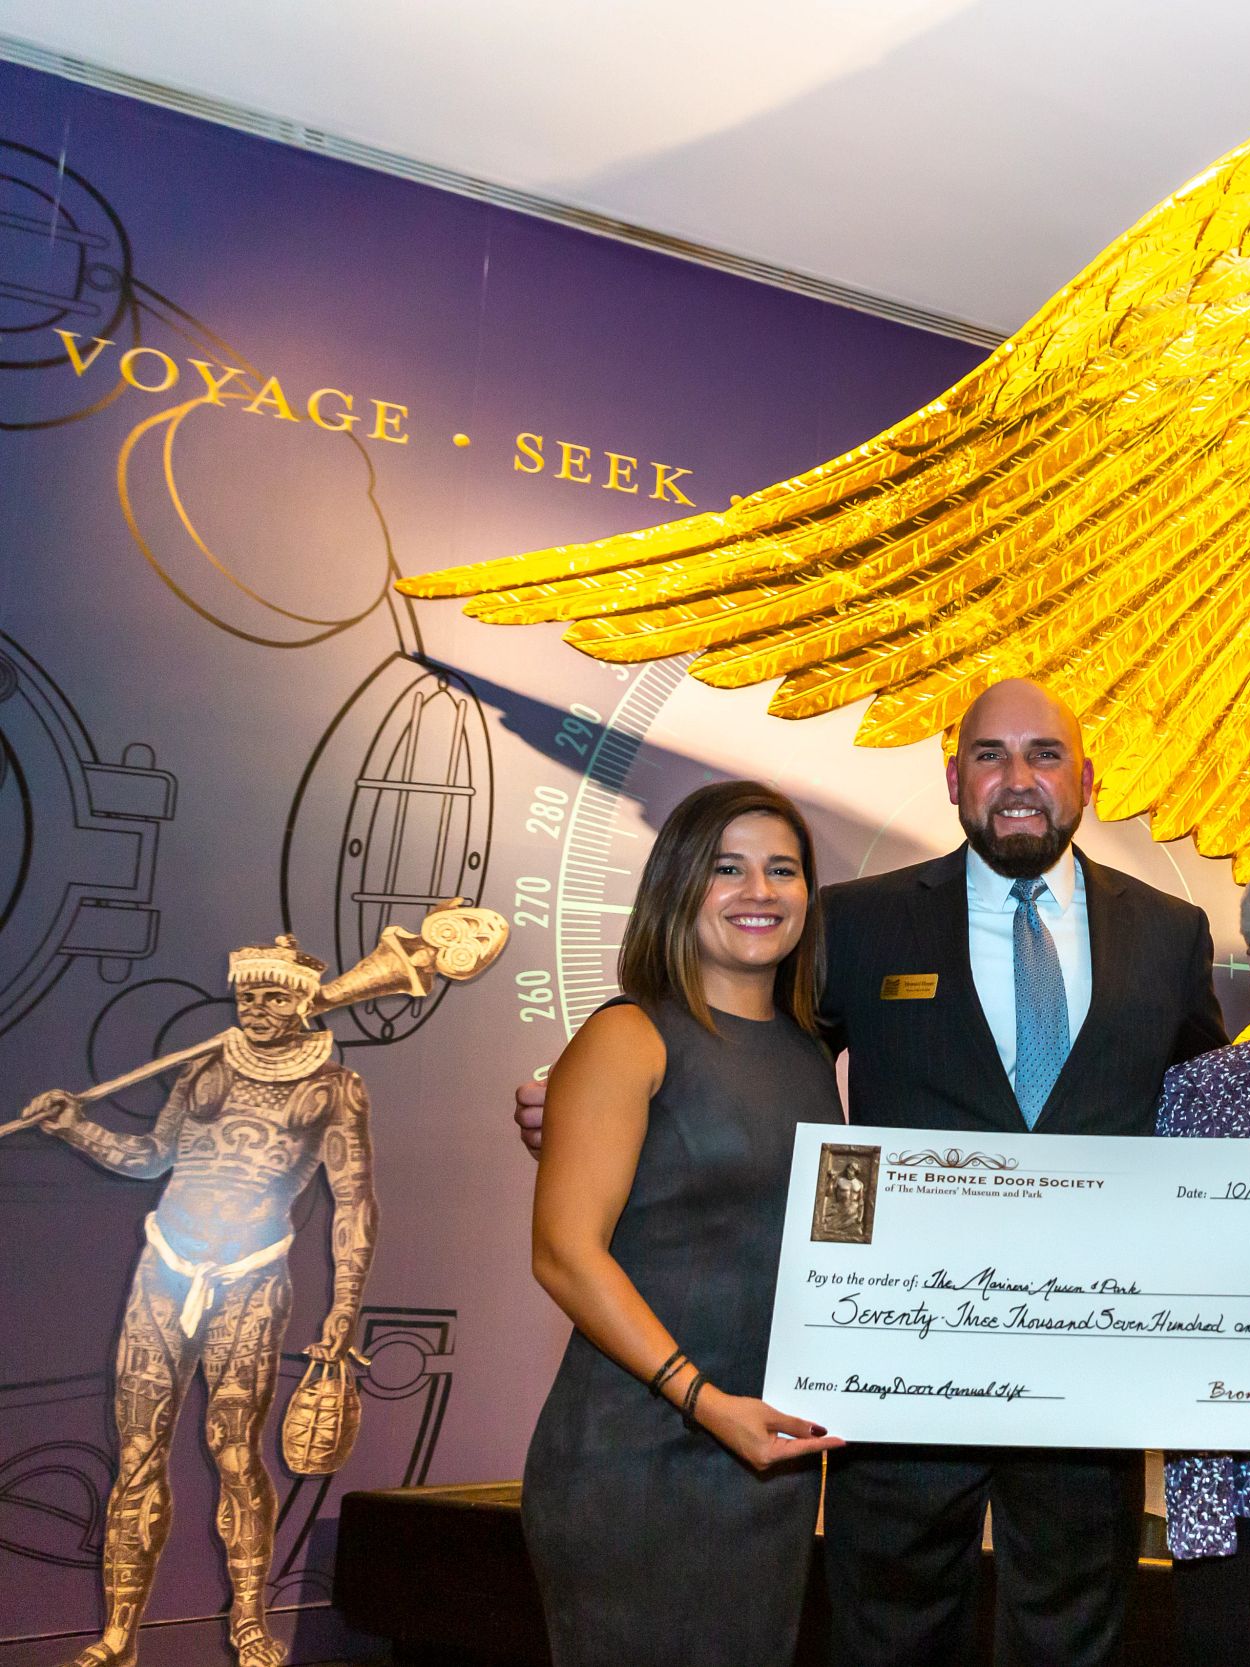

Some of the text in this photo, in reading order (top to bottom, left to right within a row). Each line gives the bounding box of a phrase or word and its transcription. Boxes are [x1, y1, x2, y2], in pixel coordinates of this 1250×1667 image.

[53, 328, 411, 445] VOYAGE
[513, 432, 697, 508] SEEK
[555, 703, 602, 757] 290
[526, 785, 569, 840] 280
[513, 876, 552, 929] 270
[515, 970, 556, 1023] 260
[885, 1184, 895, 1193] of
[896, 1184, 913, 1194] The
[962, 1187, 1000, 1198] Museum
[1002, 1189, 1020, 1199] and
[1022, 1190, 1043, 1199] Park
[886, 1170, 1105, 1189] THE BRONZE DOOR SOCIETY
[1176, 1185, 1208, 1199] Date:
[807, 1269, 828, 1287] Pay
[832, 1273, 843, 1286] to
[847, 1271, 864, 1287] the
[868, 1273, 899, 1288] order
[903, 1273, 919, 1290] of:
[924, 1268, 957, 1291] The
[1099, 1278, 1143, 1295] Park
[1003, 1302, 1096, 1330] Thousand
[1096, 1307, 1148, 1332] Seven
[1148, 1309, 1226, 1333] Hundred
[794, 1376, 838, 1392] Memo:
[893, 1376, 934, 1395] Door
[936, 1380, 996, 1399] Annual
